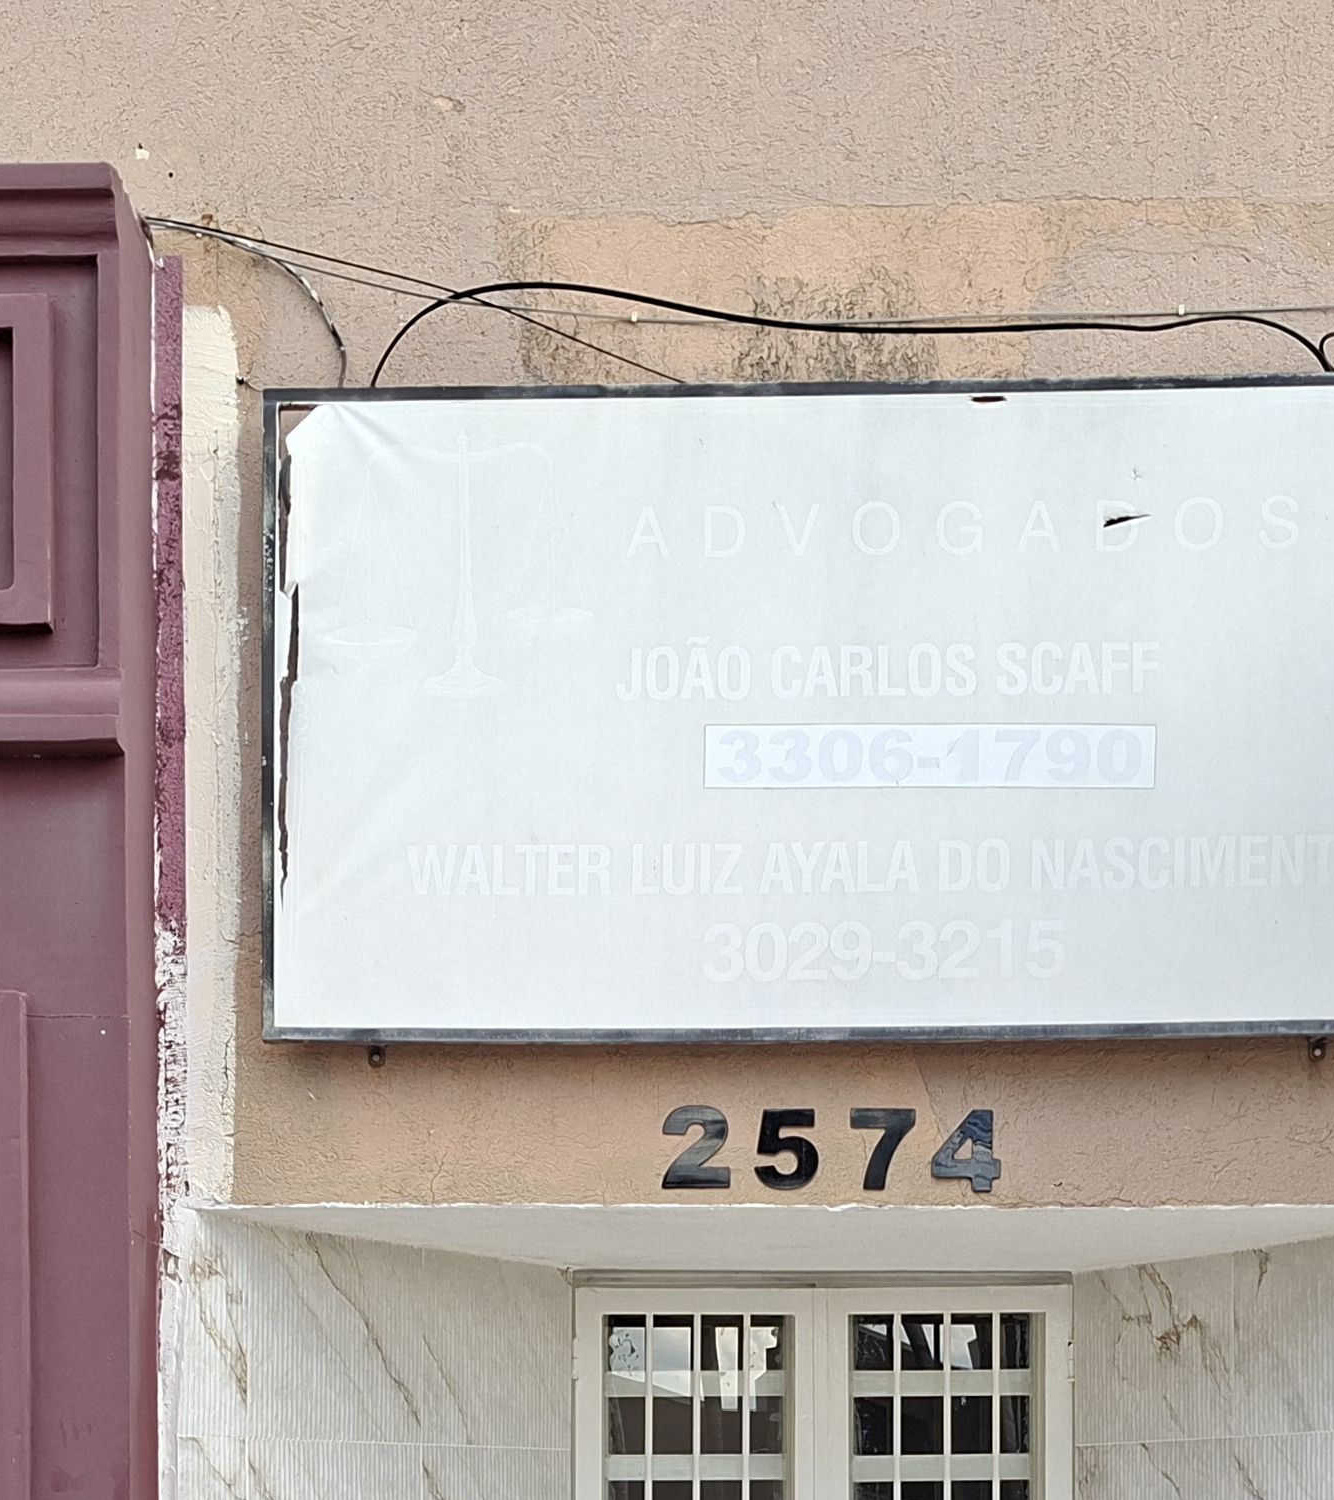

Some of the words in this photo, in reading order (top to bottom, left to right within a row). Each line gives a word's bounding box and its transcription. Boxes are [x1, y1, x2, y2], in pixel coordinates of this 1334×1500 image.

[626, 495, 1301, 559] ADVOGADOS
[616, 634, 751, 701] JOÃO
[771, 642, 978, 700] CARLOS
[995, 640, 1161, 697] SCAFF
[718, 728, 1143, 782] 3306-1790
[404, 842, 611, 896] WALTER
[631, 842, 744, 896] LUIZ
[759, 840, 920, 895] AYALA
[938, 838, 1012, 893] DO
[702, 919, 1068, 982] 3029-3215
[661, 1104, 1002, 1192] 2574
